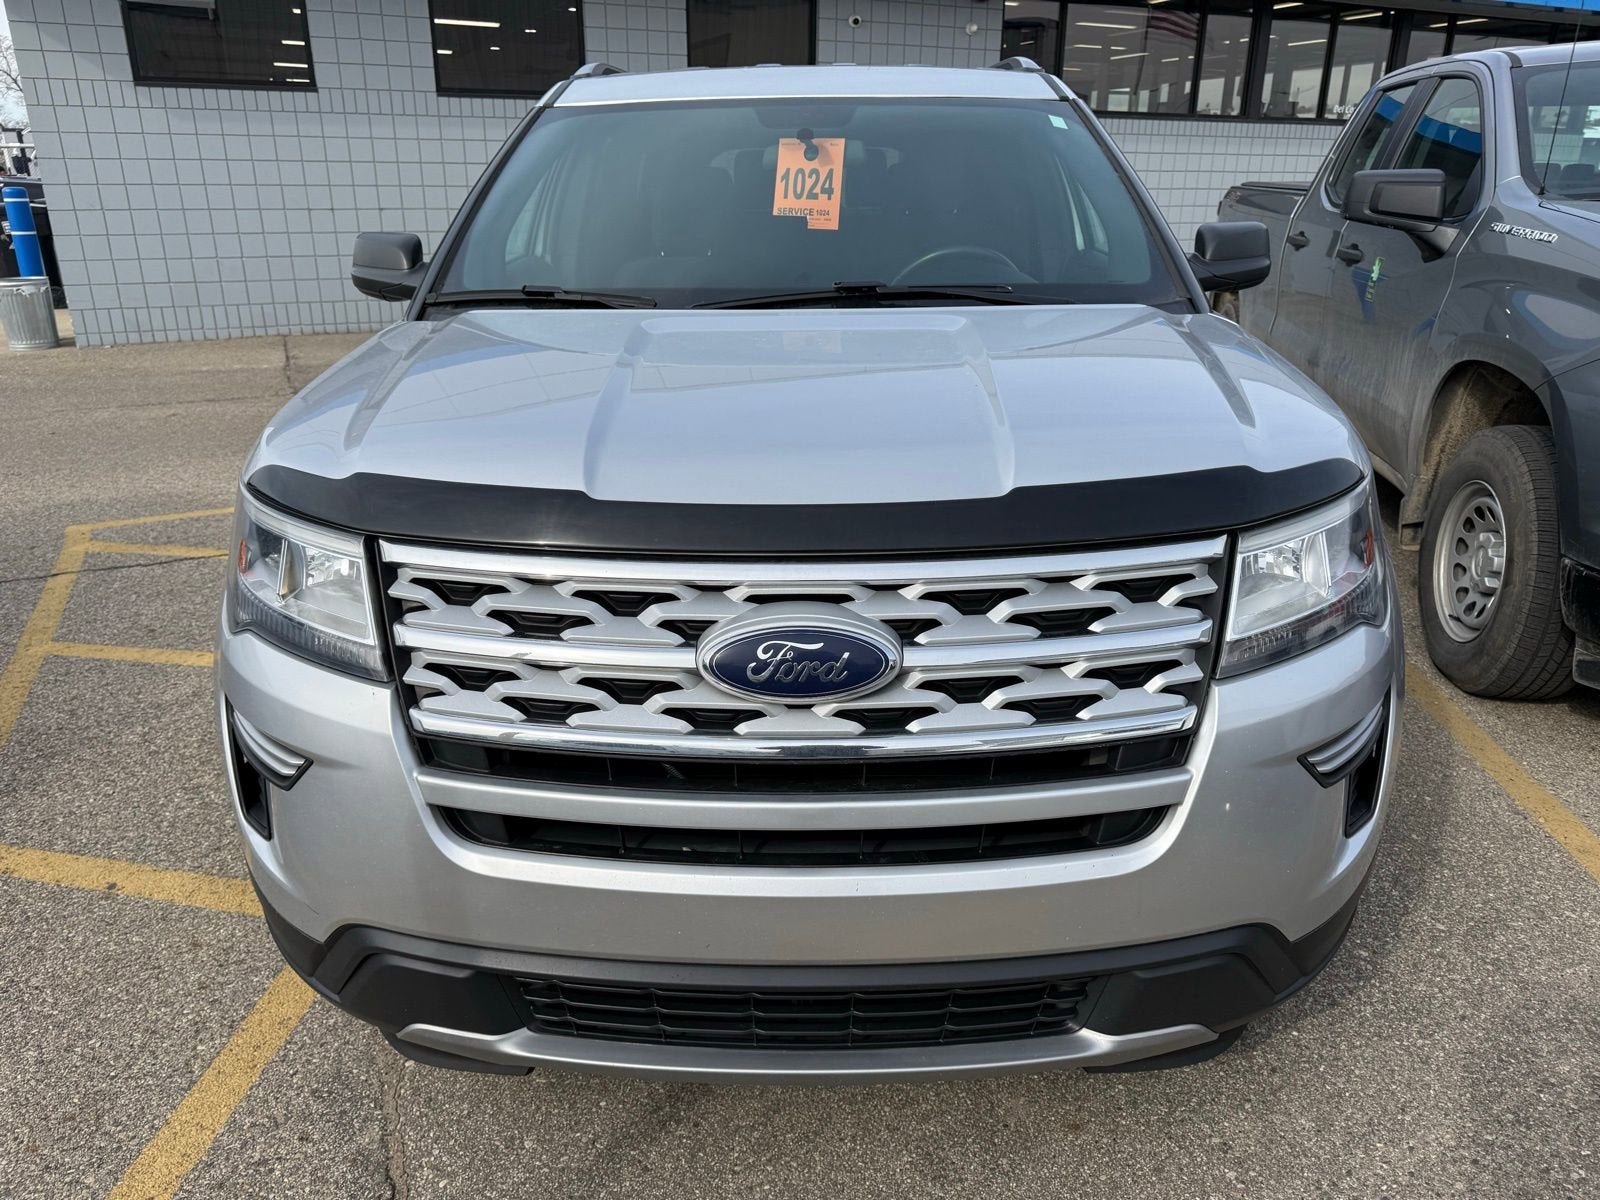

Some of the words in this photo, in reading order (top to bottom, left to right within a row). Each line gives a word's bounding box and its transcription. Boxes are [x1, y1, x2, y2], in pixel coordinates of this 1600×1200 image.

[780, 168, 834, 200] 1024
[777, 207, 814, 216] SERVICE
[1489, 222, 1558, 243] SILVERADO
[747, 640, 850, 683] Ford
